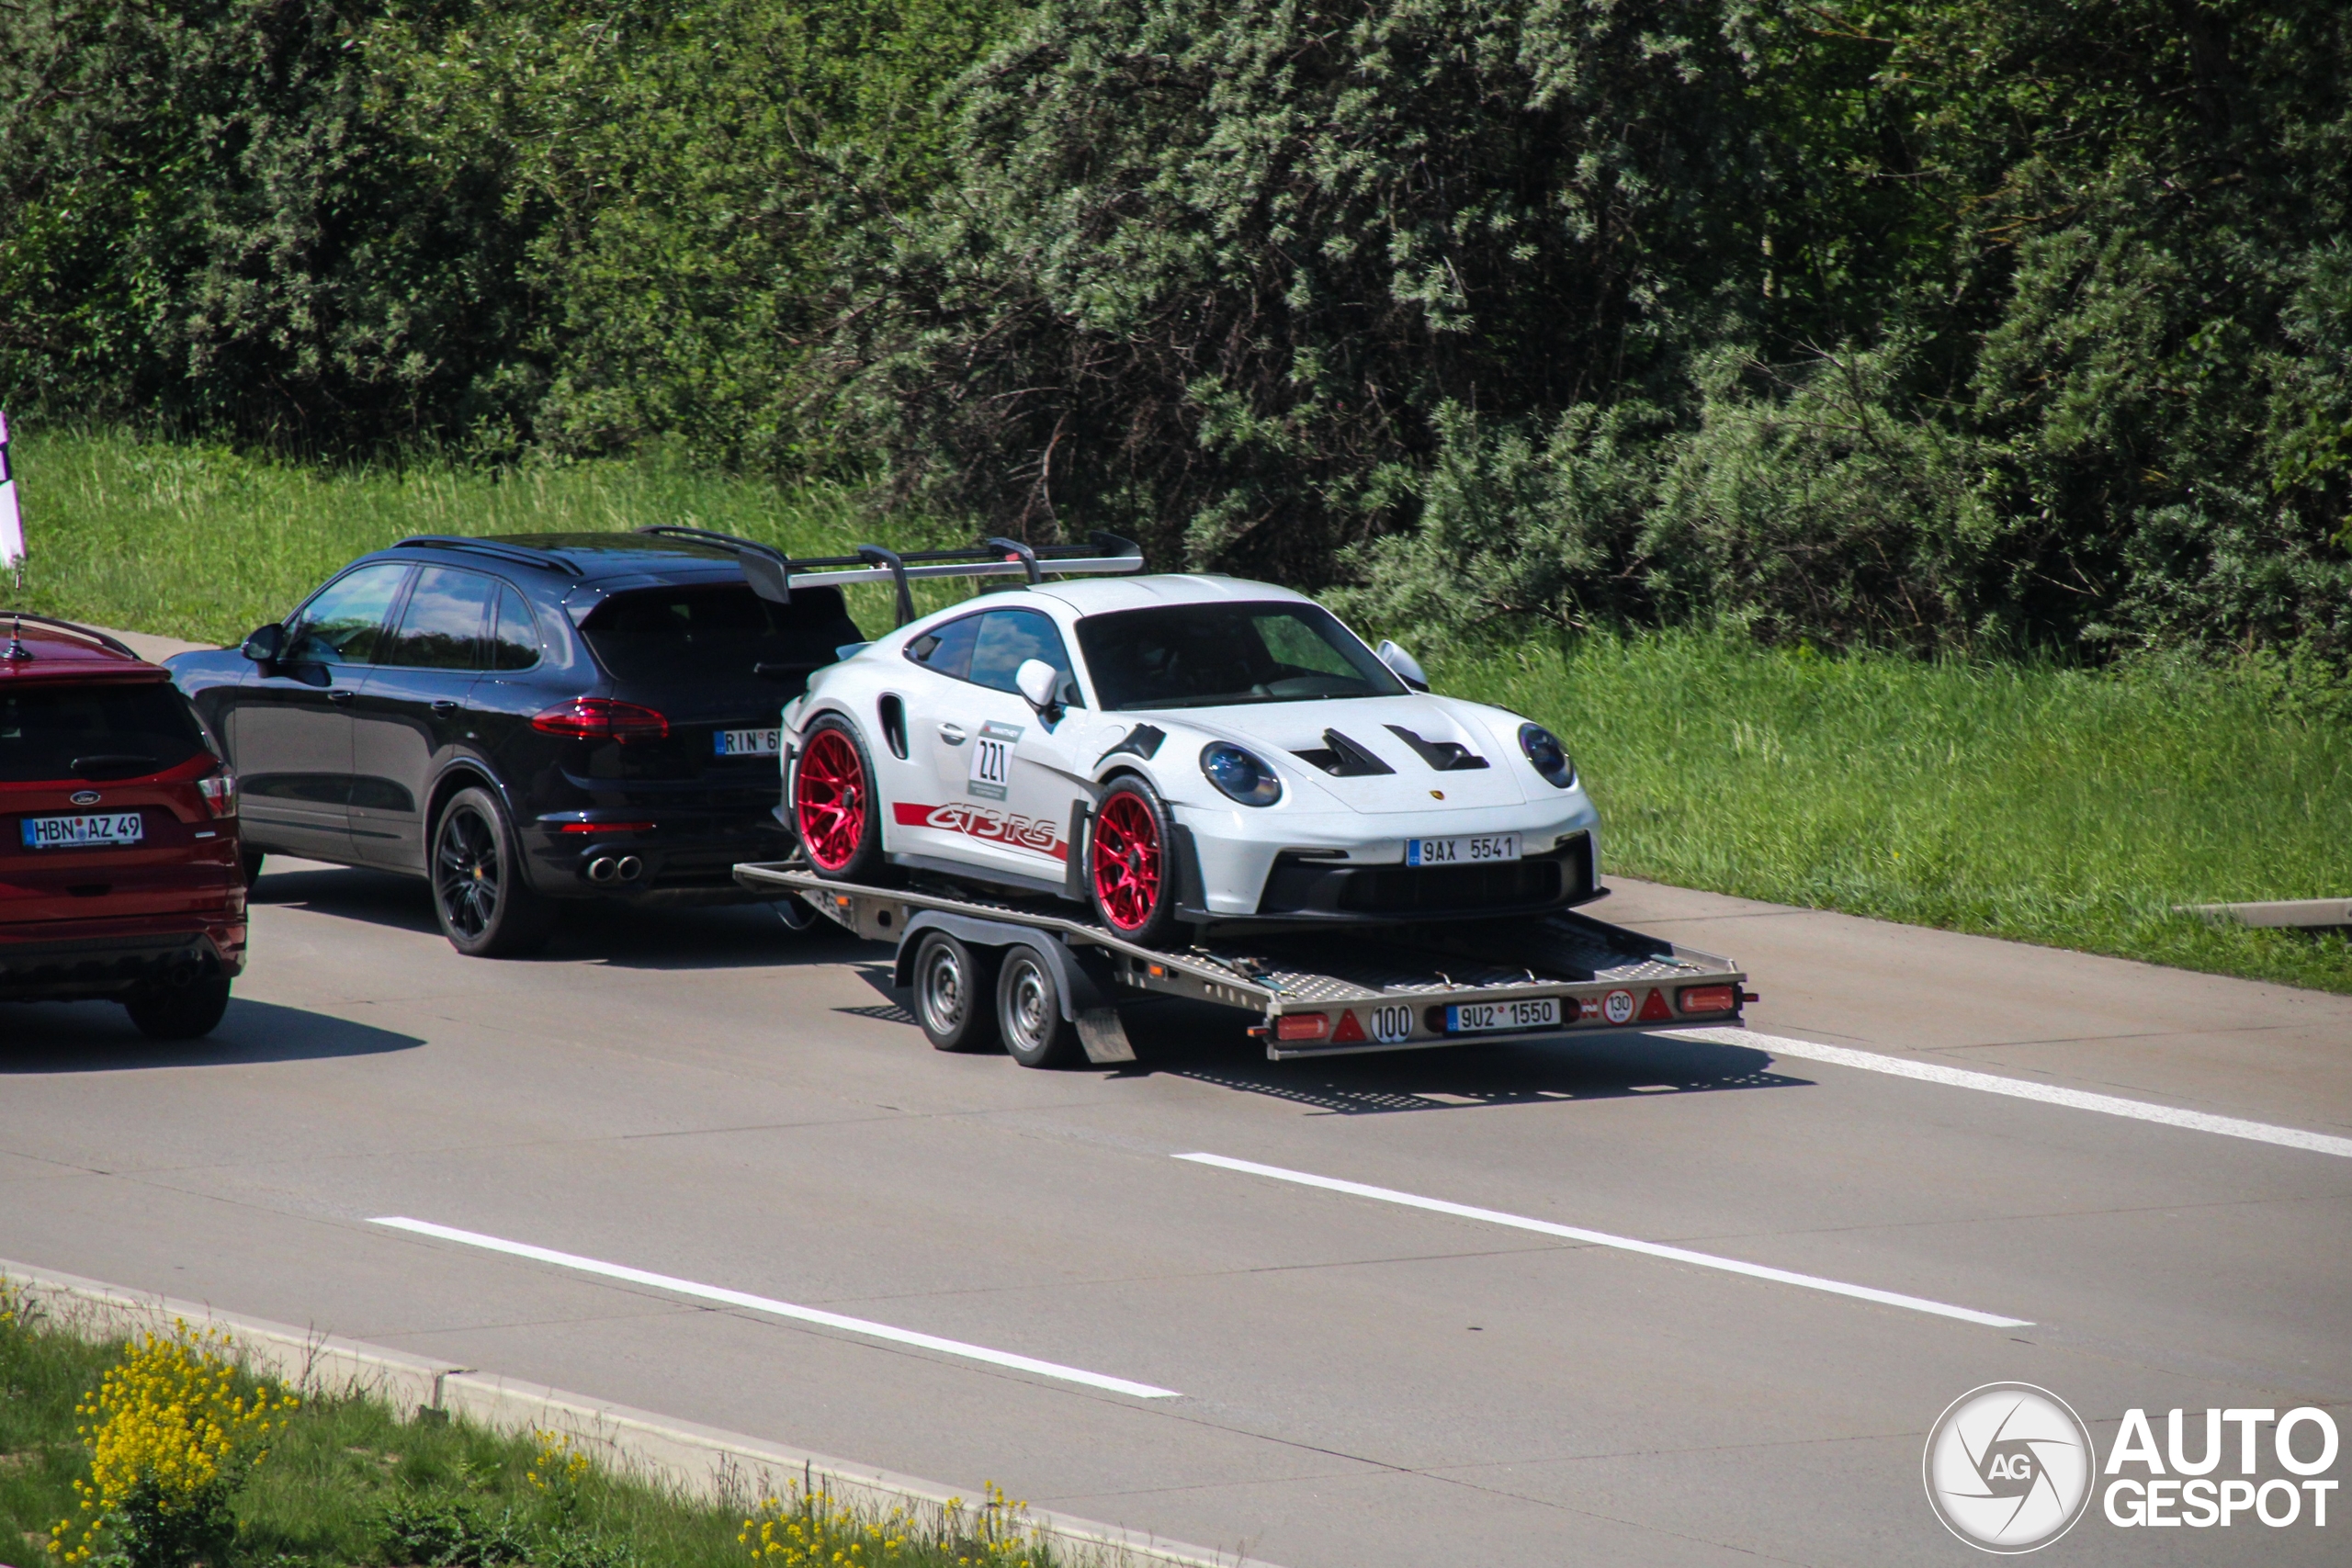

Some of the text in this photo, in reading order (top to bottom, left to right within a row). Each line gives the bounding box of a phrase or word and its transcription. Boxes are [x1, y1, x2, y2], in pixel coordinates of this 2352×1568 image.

[726, 732, 758, 752] RIN
[978, 739, 1005, 783] 221
[35, 816, 140, 841] HBN AZ 49
[1423, 840, 1456, 862] 9AX
[1471, 837, 1513, 860] 5541
[1461, 1006, 1495, 1029] 9U2
[1510, 1001, 1553, 1025] 1550
[1609, 995, 1630, 1012] 130
[1374, 1005, 1410, 1039] 100
